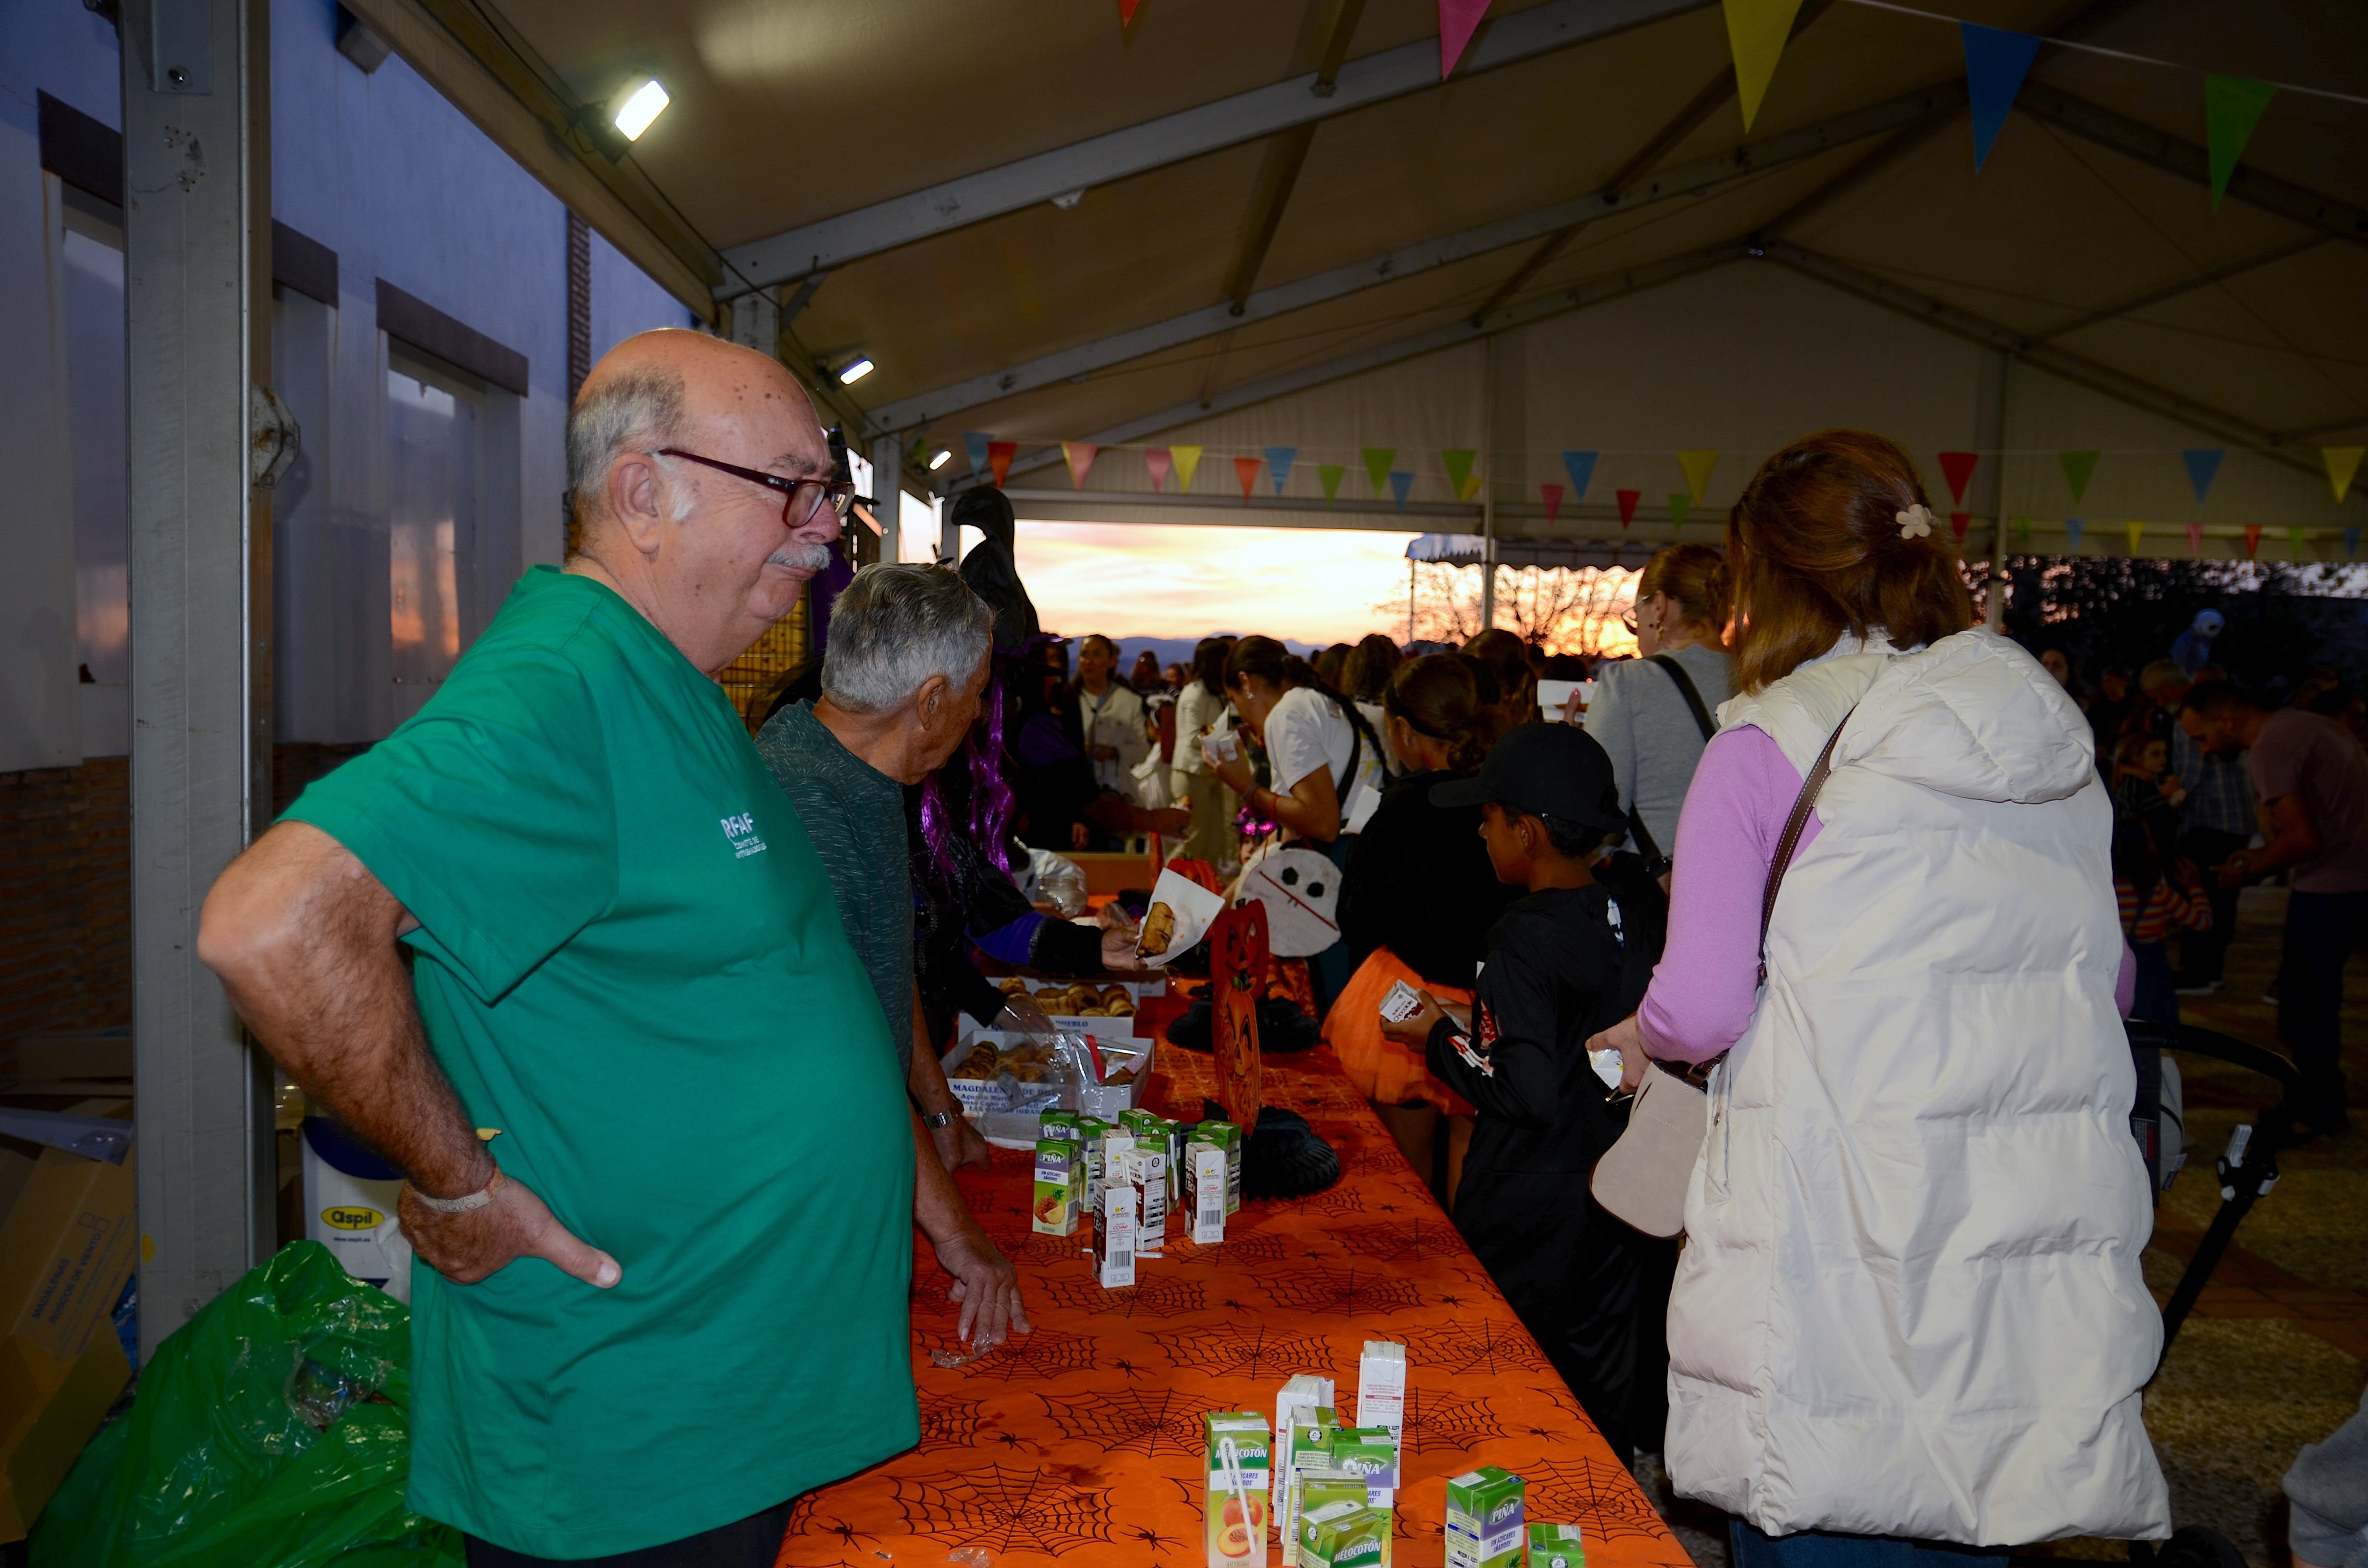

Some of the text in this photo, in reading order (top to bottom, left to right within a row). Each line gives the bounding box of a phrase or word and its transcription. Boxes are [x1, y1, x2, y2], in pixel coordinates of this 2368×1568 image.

[721, 812, 753, 839] RFAF
[953, 1084, 1007, 1094] MAGDALEN
[1042, 1153, 1062, 1164] PIÑA
[332, 1211, 372, 1229] aspil
[32, 1258, 71, 1319] MADALENAS
[1357, 1461, 1381, 1475] IÑA
[1492, 1503, 1515, 1523] PIÑA
[1497, 1531, 1516, 1544] AZÚCARES
[1332, 1540, 1381, 1563] MELOCOTÓN
